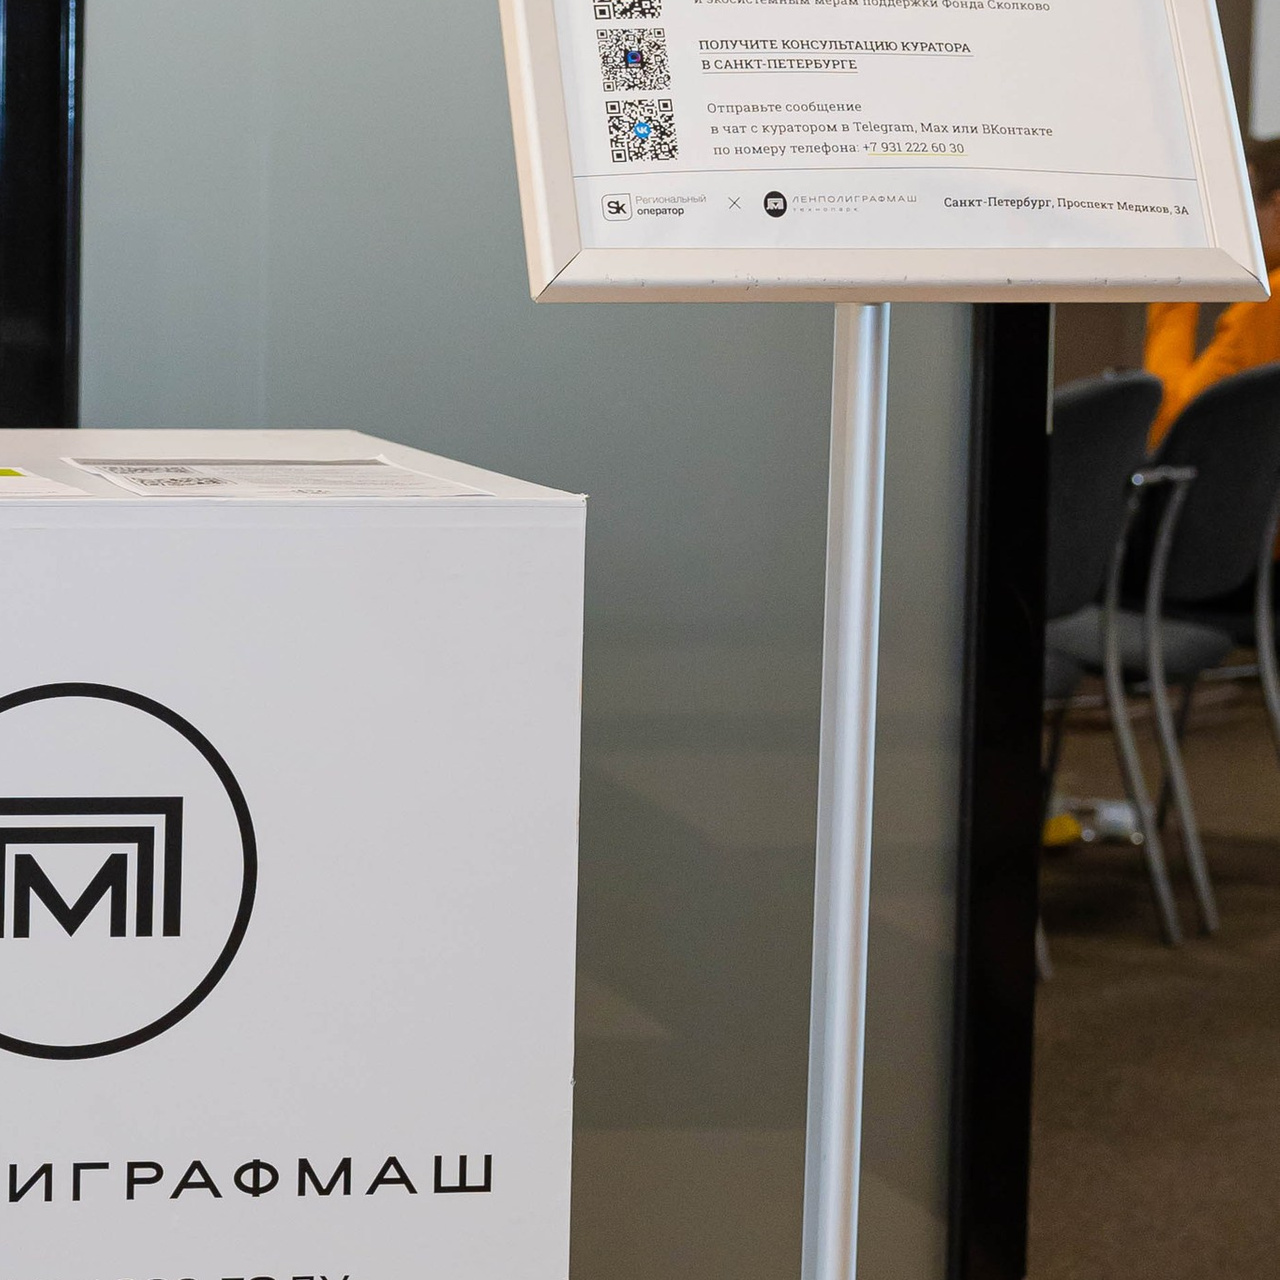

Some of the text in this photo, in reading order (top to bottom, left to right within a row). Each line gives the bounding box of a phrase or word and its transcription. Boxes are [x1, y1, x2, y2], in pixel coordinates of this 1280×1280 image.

[988, 0, 1050, 11] Сколково
[699, 39, 971, 53] ПОЛУЧИТЕ КОНСУЛЬТАЦИЮ КУРАТОРА
[702, 59, 857, 70] В САНКТ-ПЕТЕРБУРГЕ
[707, 102, 862, 115] Отправьте сообщение
[711, 121, 1053, 136] в чат с куратором в Telegram, Max или ВКонтакте
[714, 142, 964, 156] по номеру телефона: +7 931 222 60 30
[635, 194, 706, 204] Региональный
[792, 195, 917, 203] ЛЕНПОЛИГРАФМАШ
[943, 196, 1055, 209] Санкт-Петербург,
[1057, 198, 1114, 210] Проспект
[1117, 201, 1173, 215] Медиков,
[607, 200, 627, 214] Sk
[637, 206, 684, 216] оператор
